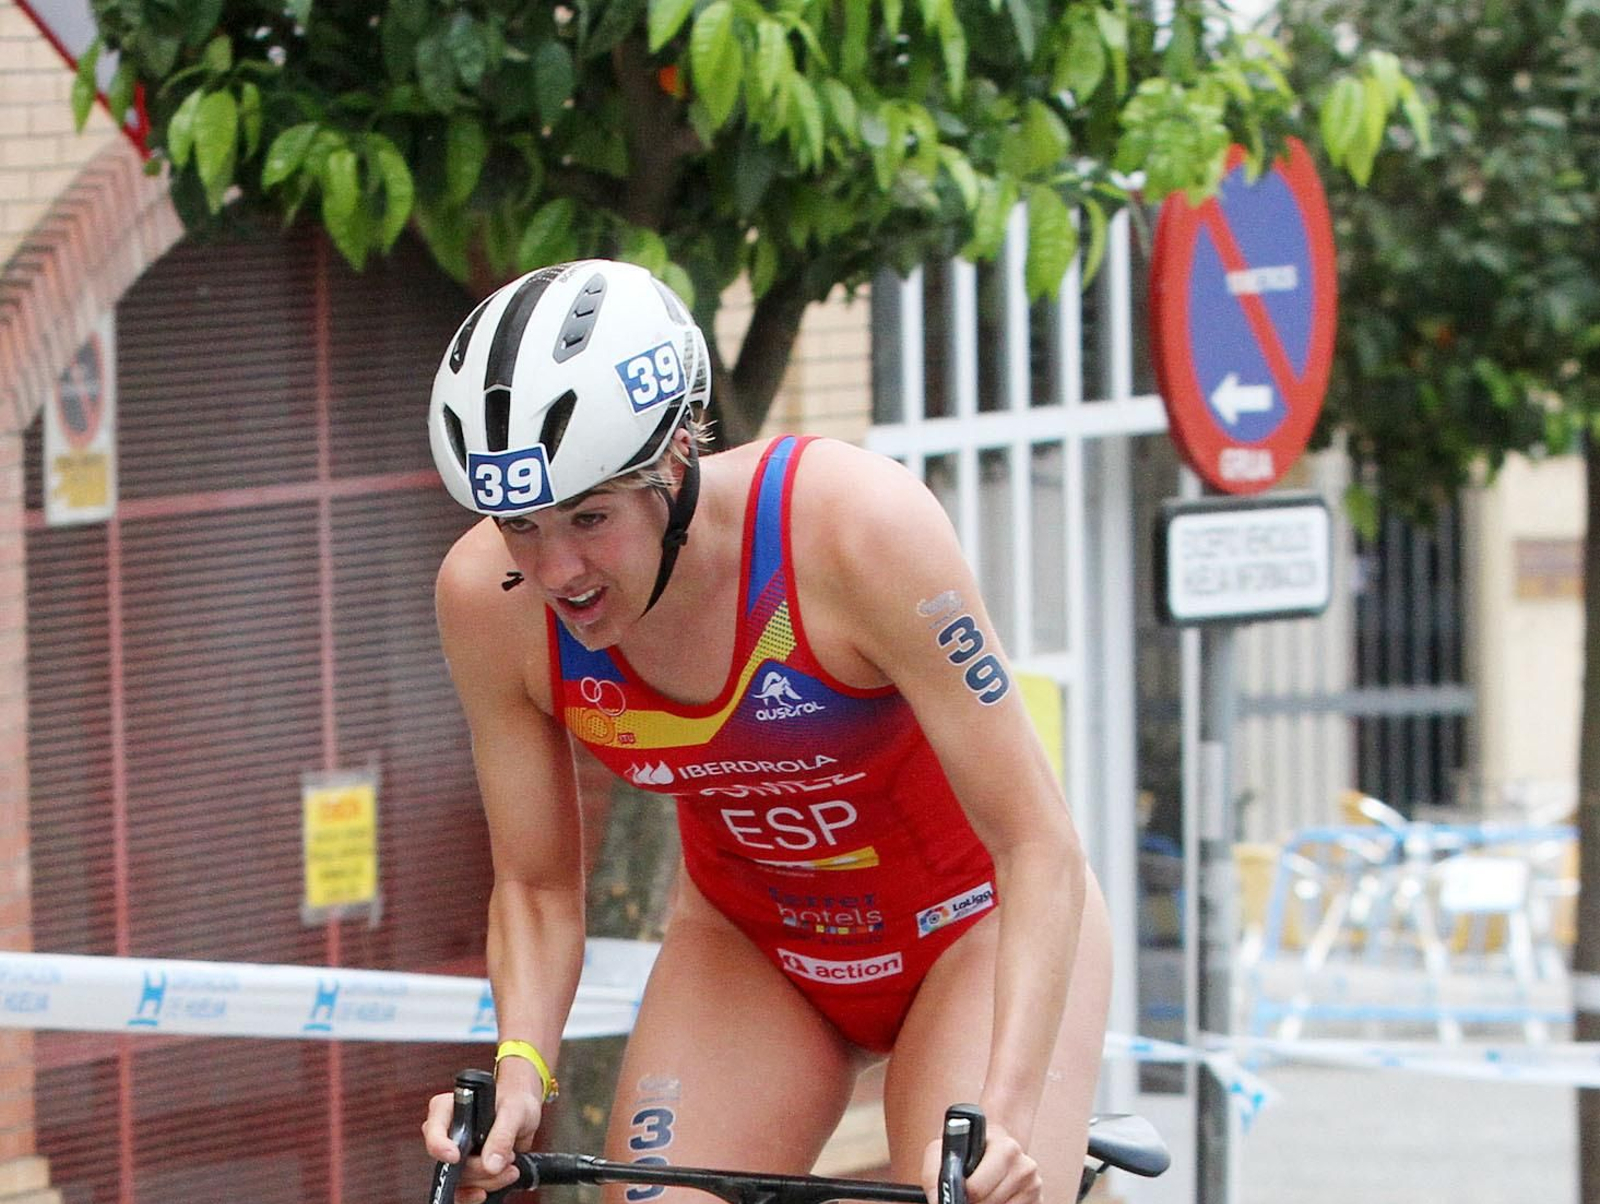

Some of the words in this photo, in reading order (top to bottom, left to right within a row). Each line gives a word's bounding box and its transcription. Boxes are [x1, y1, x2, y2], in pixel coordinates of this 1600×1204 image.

[627, 345, 680, 405] 39
[475, 457, 543, 506] 39
[936, 613, 1010, 706] 39
[678, 754, 838, 780] IBERDROLA
[721, 800, 858, 851] ESP
[815, 957, 899, 980] action
